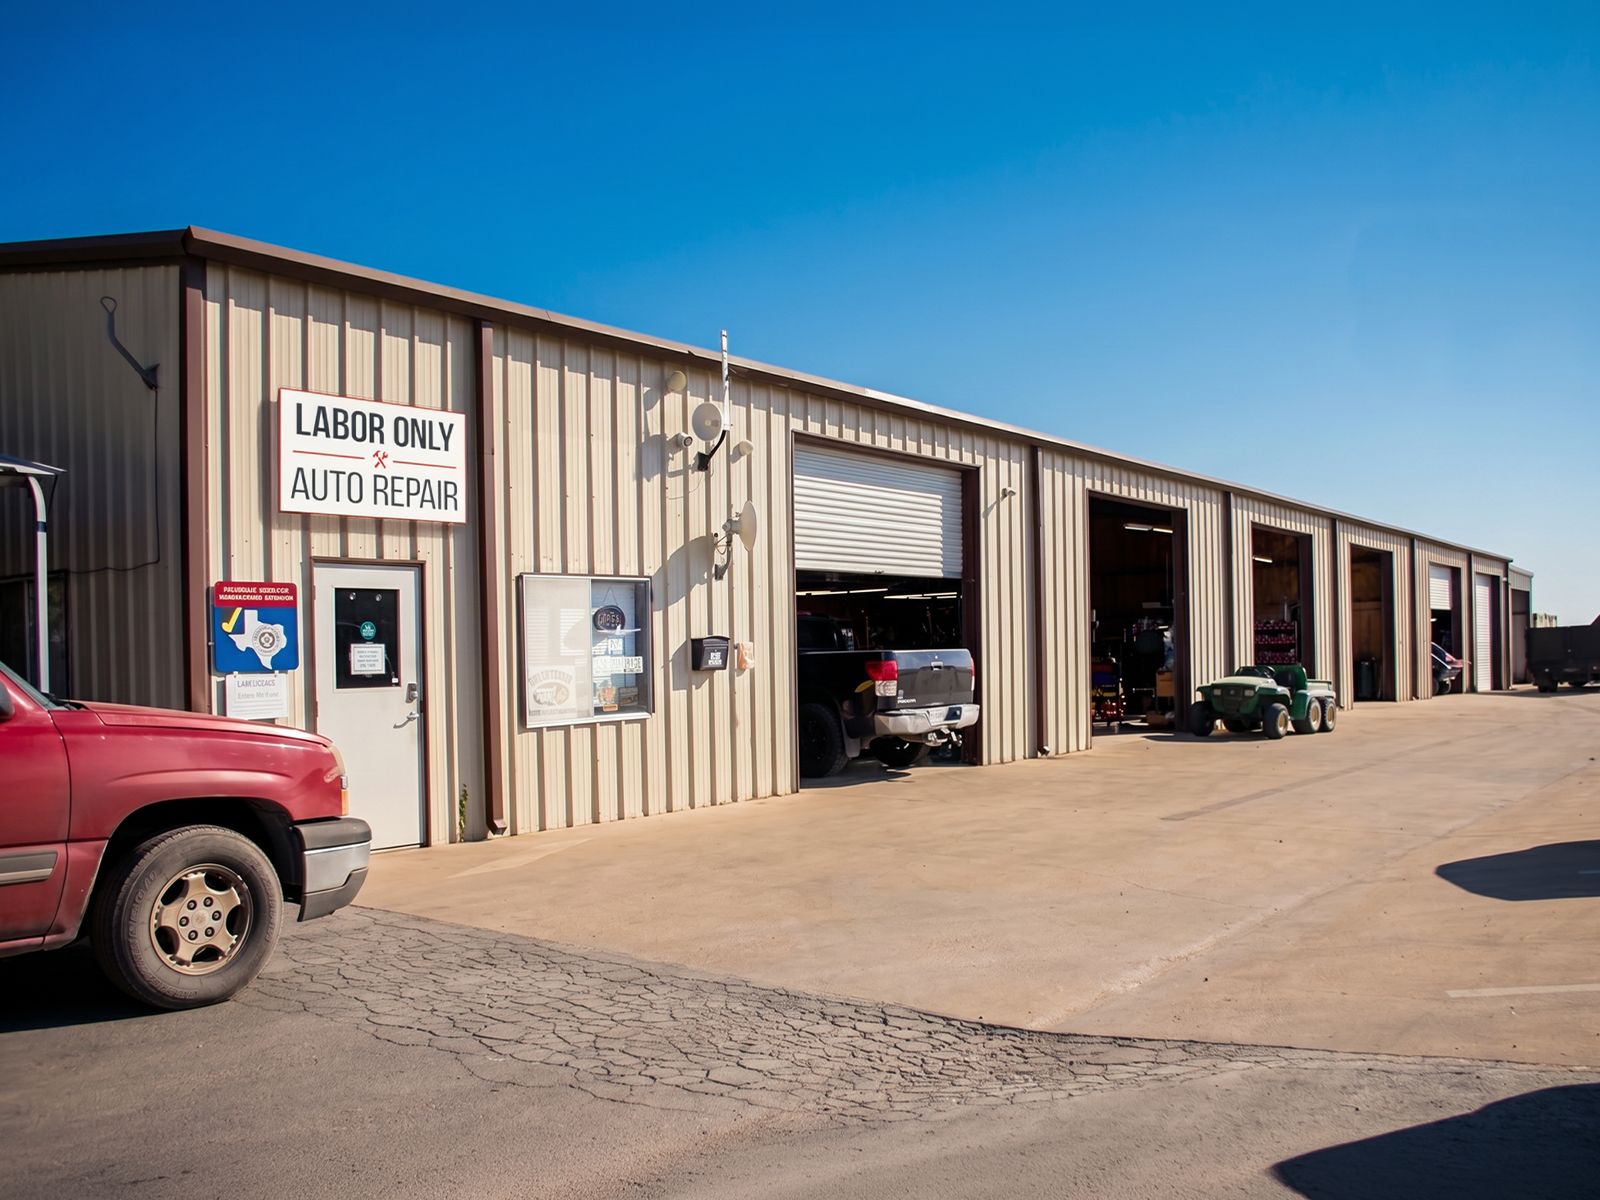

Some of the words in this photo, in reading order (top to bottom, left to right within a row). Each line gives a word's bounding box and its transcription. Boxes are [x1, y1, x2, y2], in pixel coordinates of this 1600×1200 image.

[296, 402, 385, 445] LABOR
[394, 416, 454, 452] ONLY
[291, 467, 363, 504] AUTO
[373, 474, 458, 511] REPAIR
